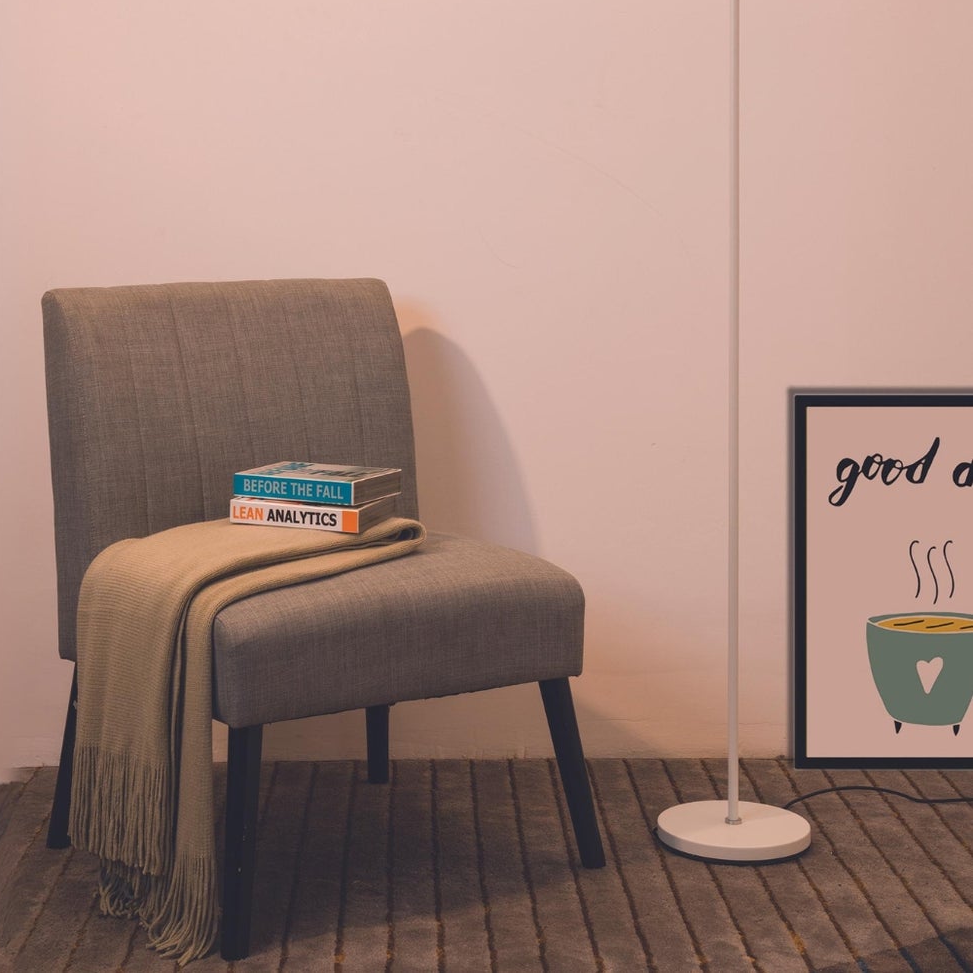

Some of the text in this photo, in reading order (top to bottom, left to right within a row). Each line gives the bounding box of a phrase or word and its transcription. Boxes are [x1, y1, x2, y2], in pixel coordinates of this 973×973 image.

[829, 437, 940, 506] good
[243, 478, 344, 500] BEFORE THE FALL
[232, 505, 337, 527] LEAN ANALYTICS
